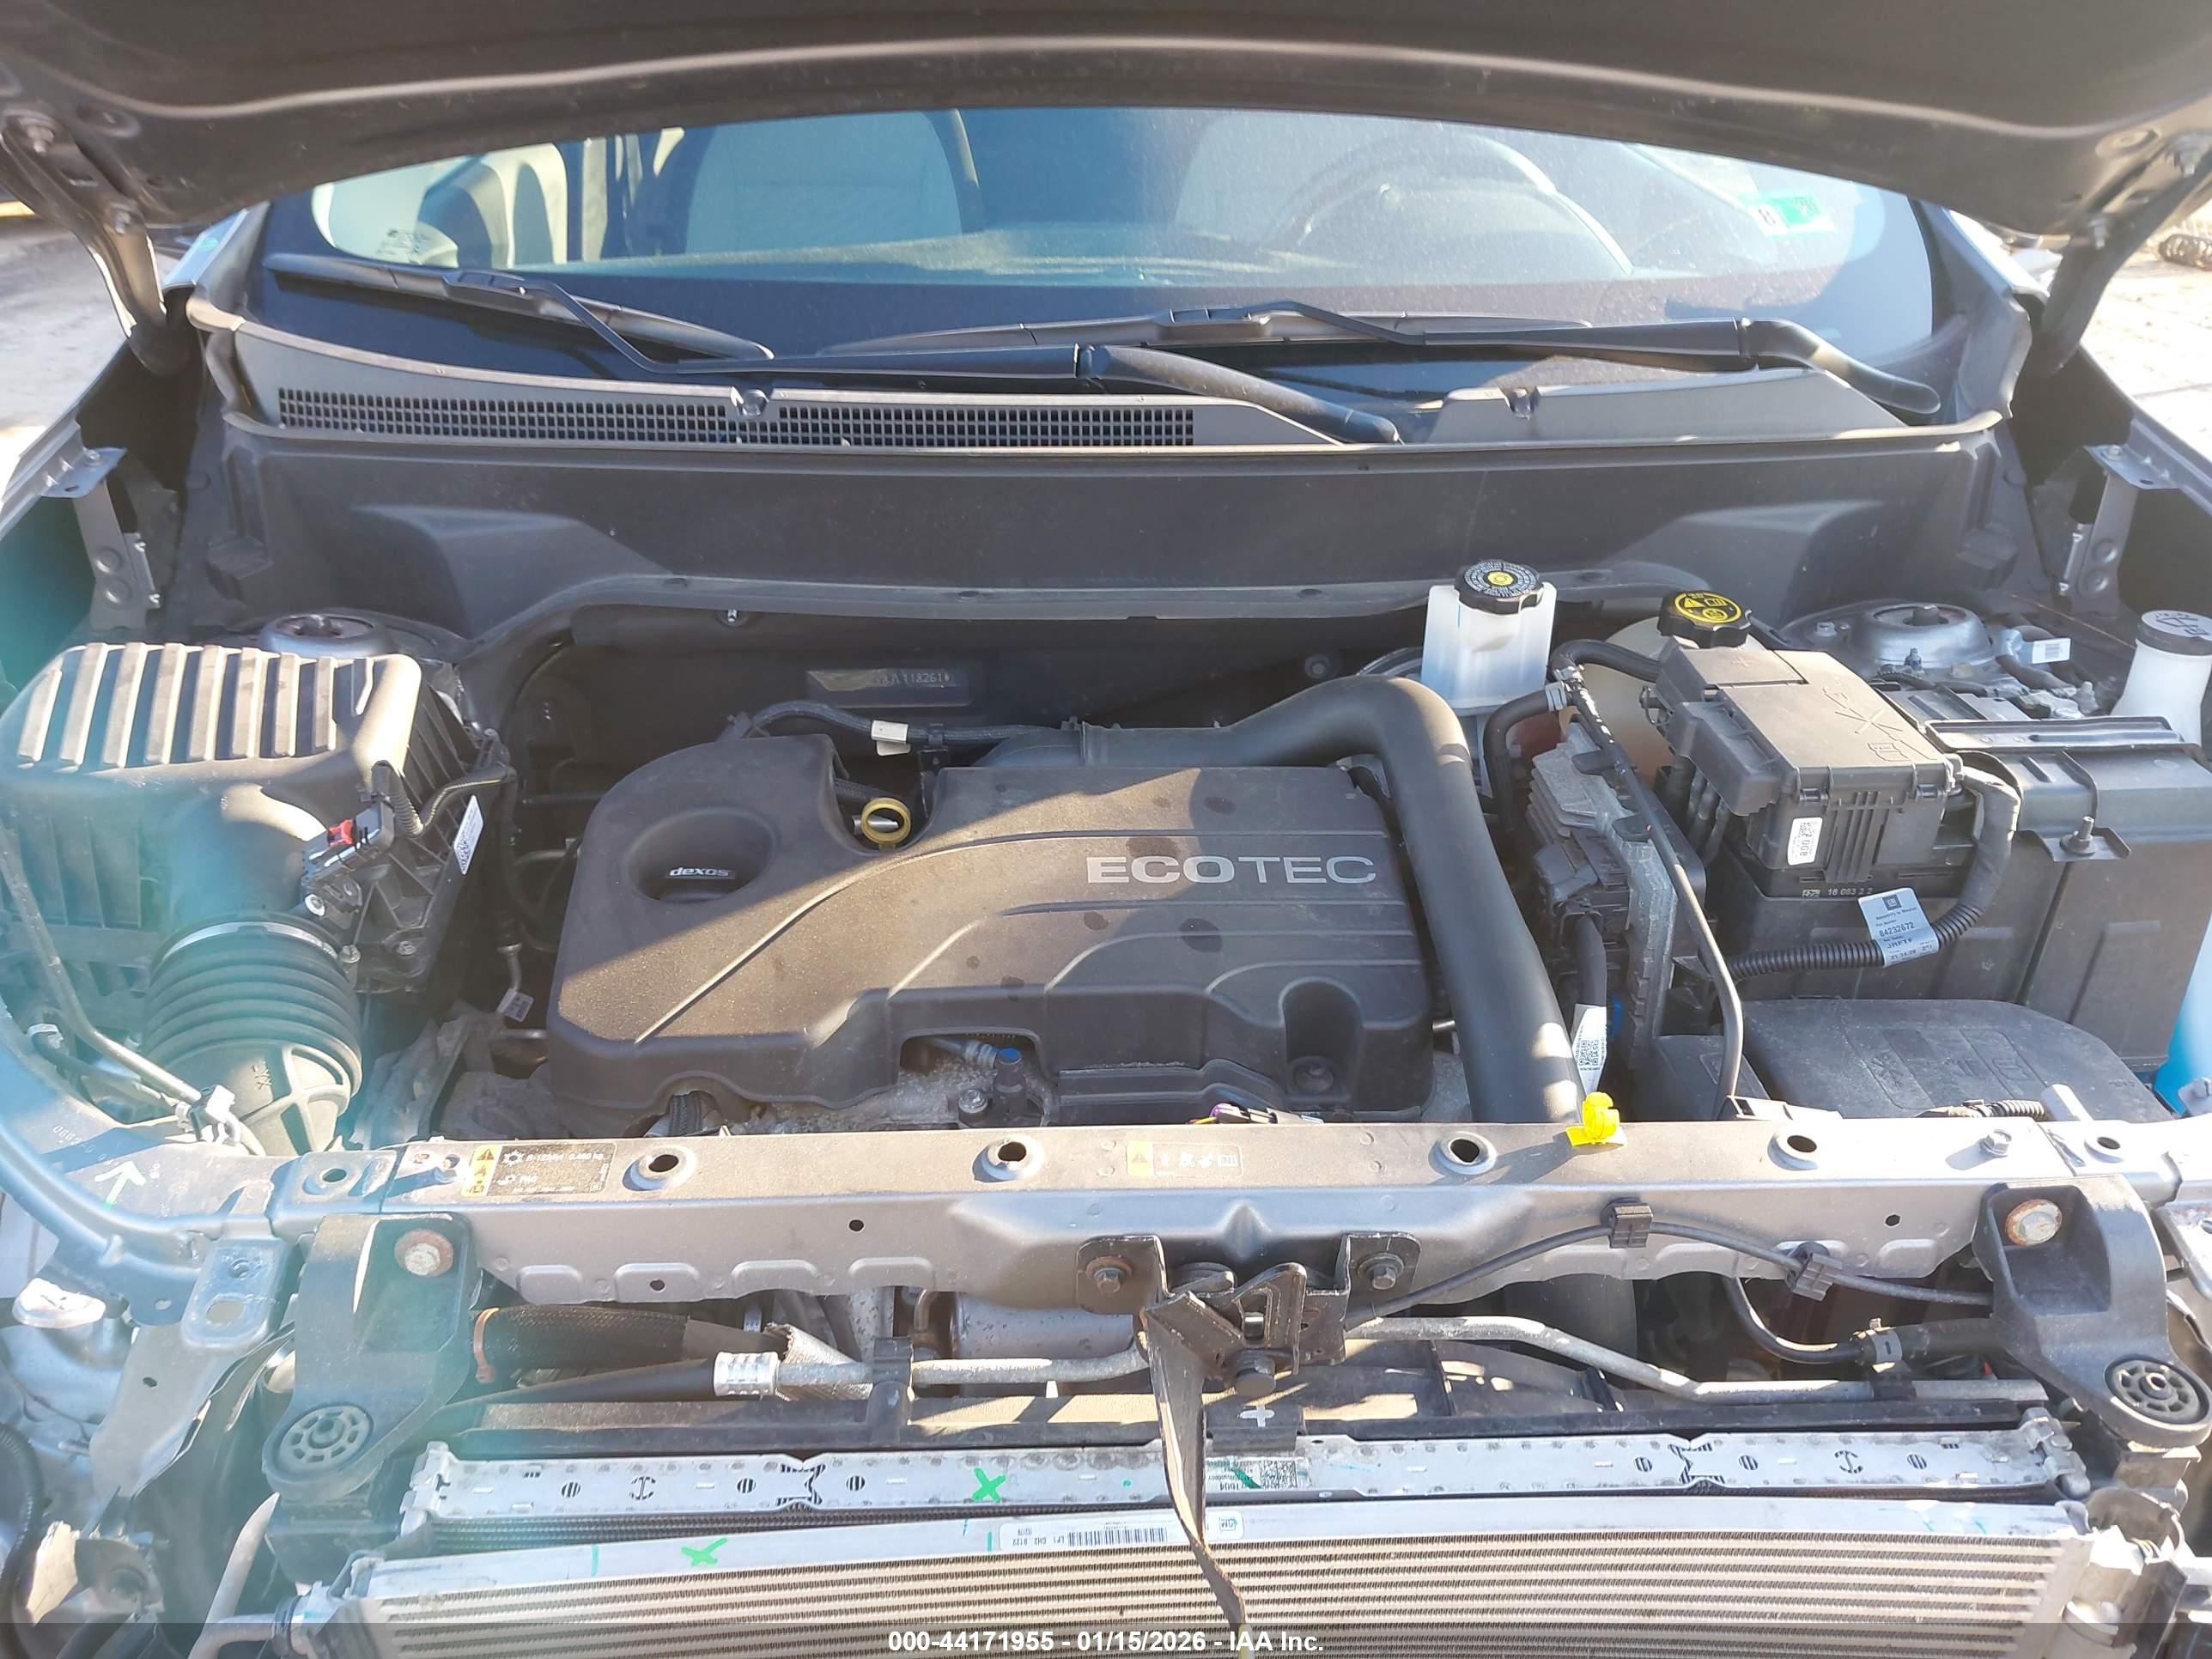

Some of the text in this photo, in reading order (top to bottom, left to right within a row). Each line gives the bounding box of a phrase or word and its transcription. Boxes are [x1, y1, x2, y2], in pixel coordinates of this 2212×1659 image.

[670, 866, 730, 877] dexos
[1086, 855, 1376, 884] ECOTEC
[1879, 921, 1916, 937] 84232672
